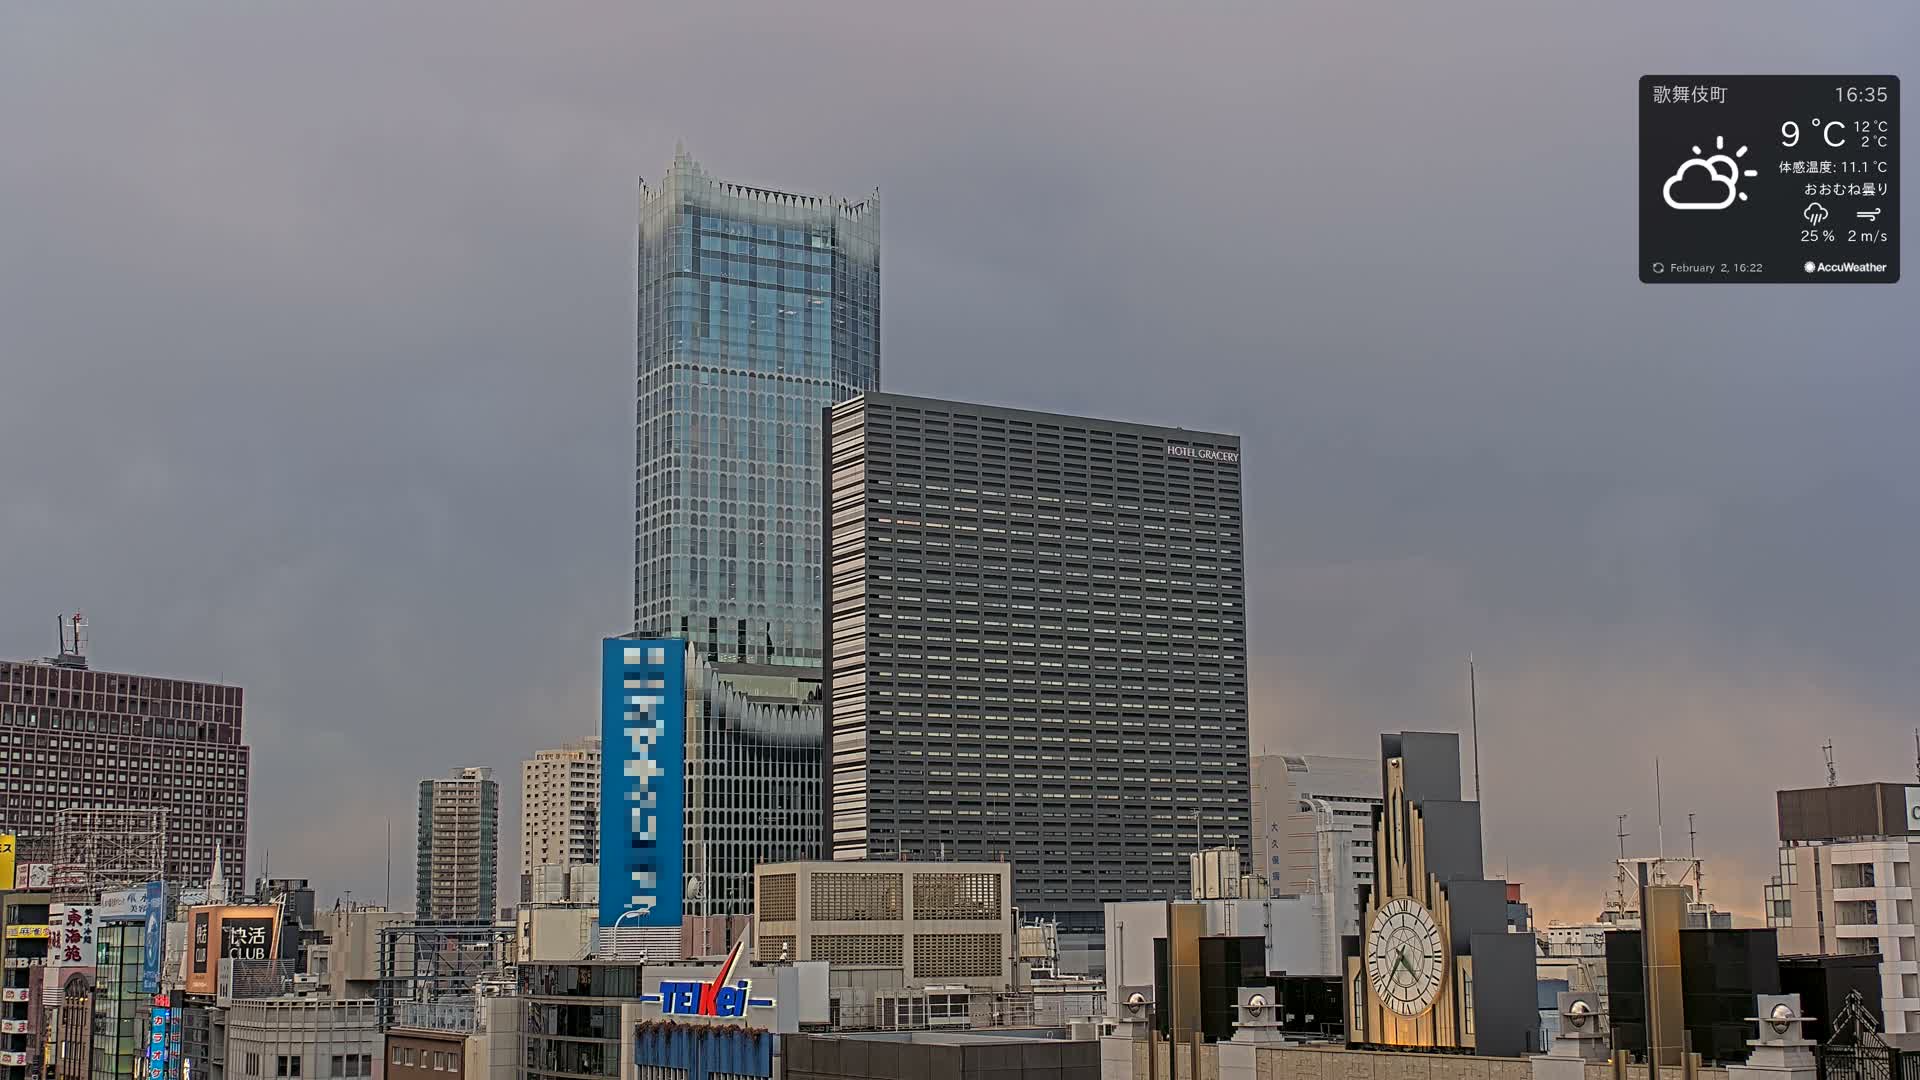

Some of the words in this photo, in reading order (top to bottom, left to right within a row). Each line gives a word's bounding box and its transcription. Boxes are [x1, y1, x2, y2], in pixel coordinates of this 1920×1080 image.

[1167, 445, 1198, 458] HOTEL
[1199, 449, 1239, 462] GRACERY
[63, 908, 83, 962] 東海苑
[231, 926, 266, 945] 快活
[230, 947, 265, 960] CLUB
[152, 1015, 163, 1078] カラオケ
